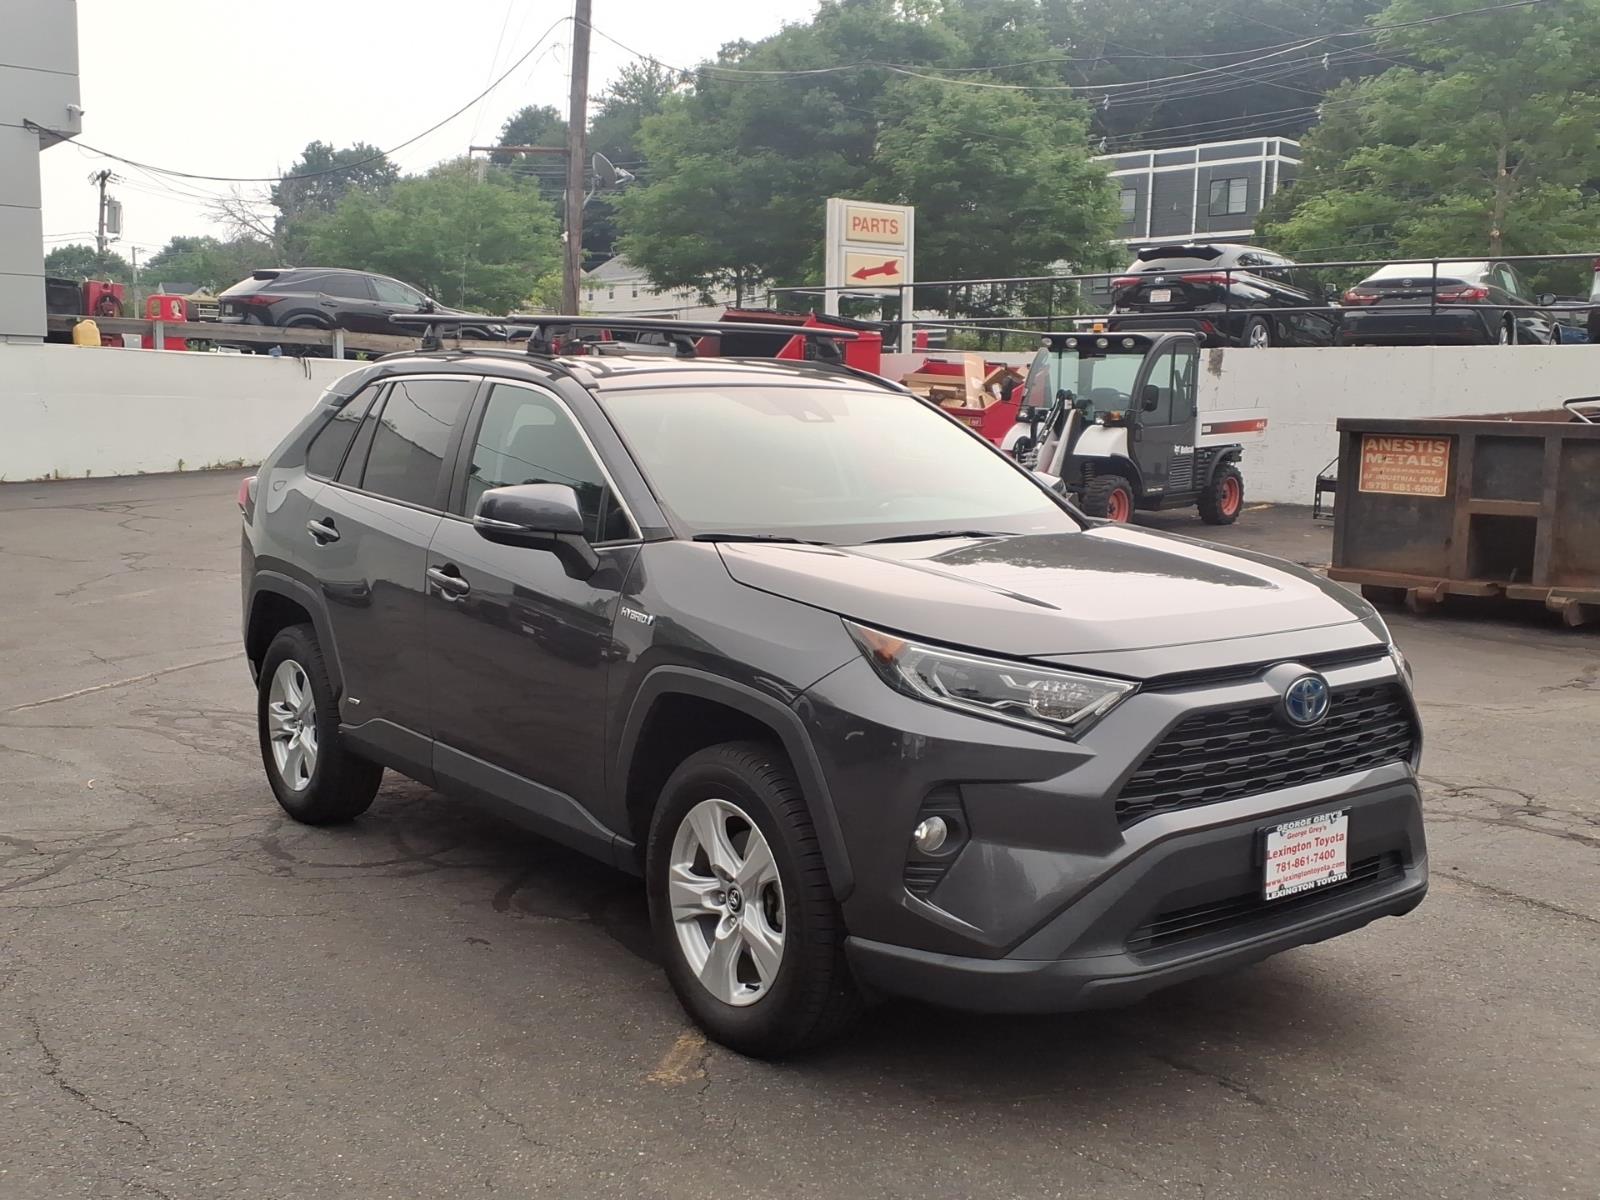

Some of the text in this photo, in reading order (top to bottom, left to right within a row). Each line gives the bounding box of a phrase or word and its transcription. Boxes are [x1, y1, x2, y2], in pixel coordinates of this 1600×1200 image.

[852, 216, 899, 235] PARTS
[1365, 438, 1446, 454] ANESTIS
[1366, 453, 1444, 467] METALS
[1375, 474, 1417, 483] INDUSTRIAL
[621, 606, 648, 624] HYBRID
[1277, 818, 1312, 832] GEORGE
[1286, 825, 1327, 840] George Grey's
[1267, 833, 1345, 860] Lexington Toyota
[1275, 849, 1336, 873] 781-861-7400
[1266, 872, 1348, 901] LEXINGTON TOYOTA
